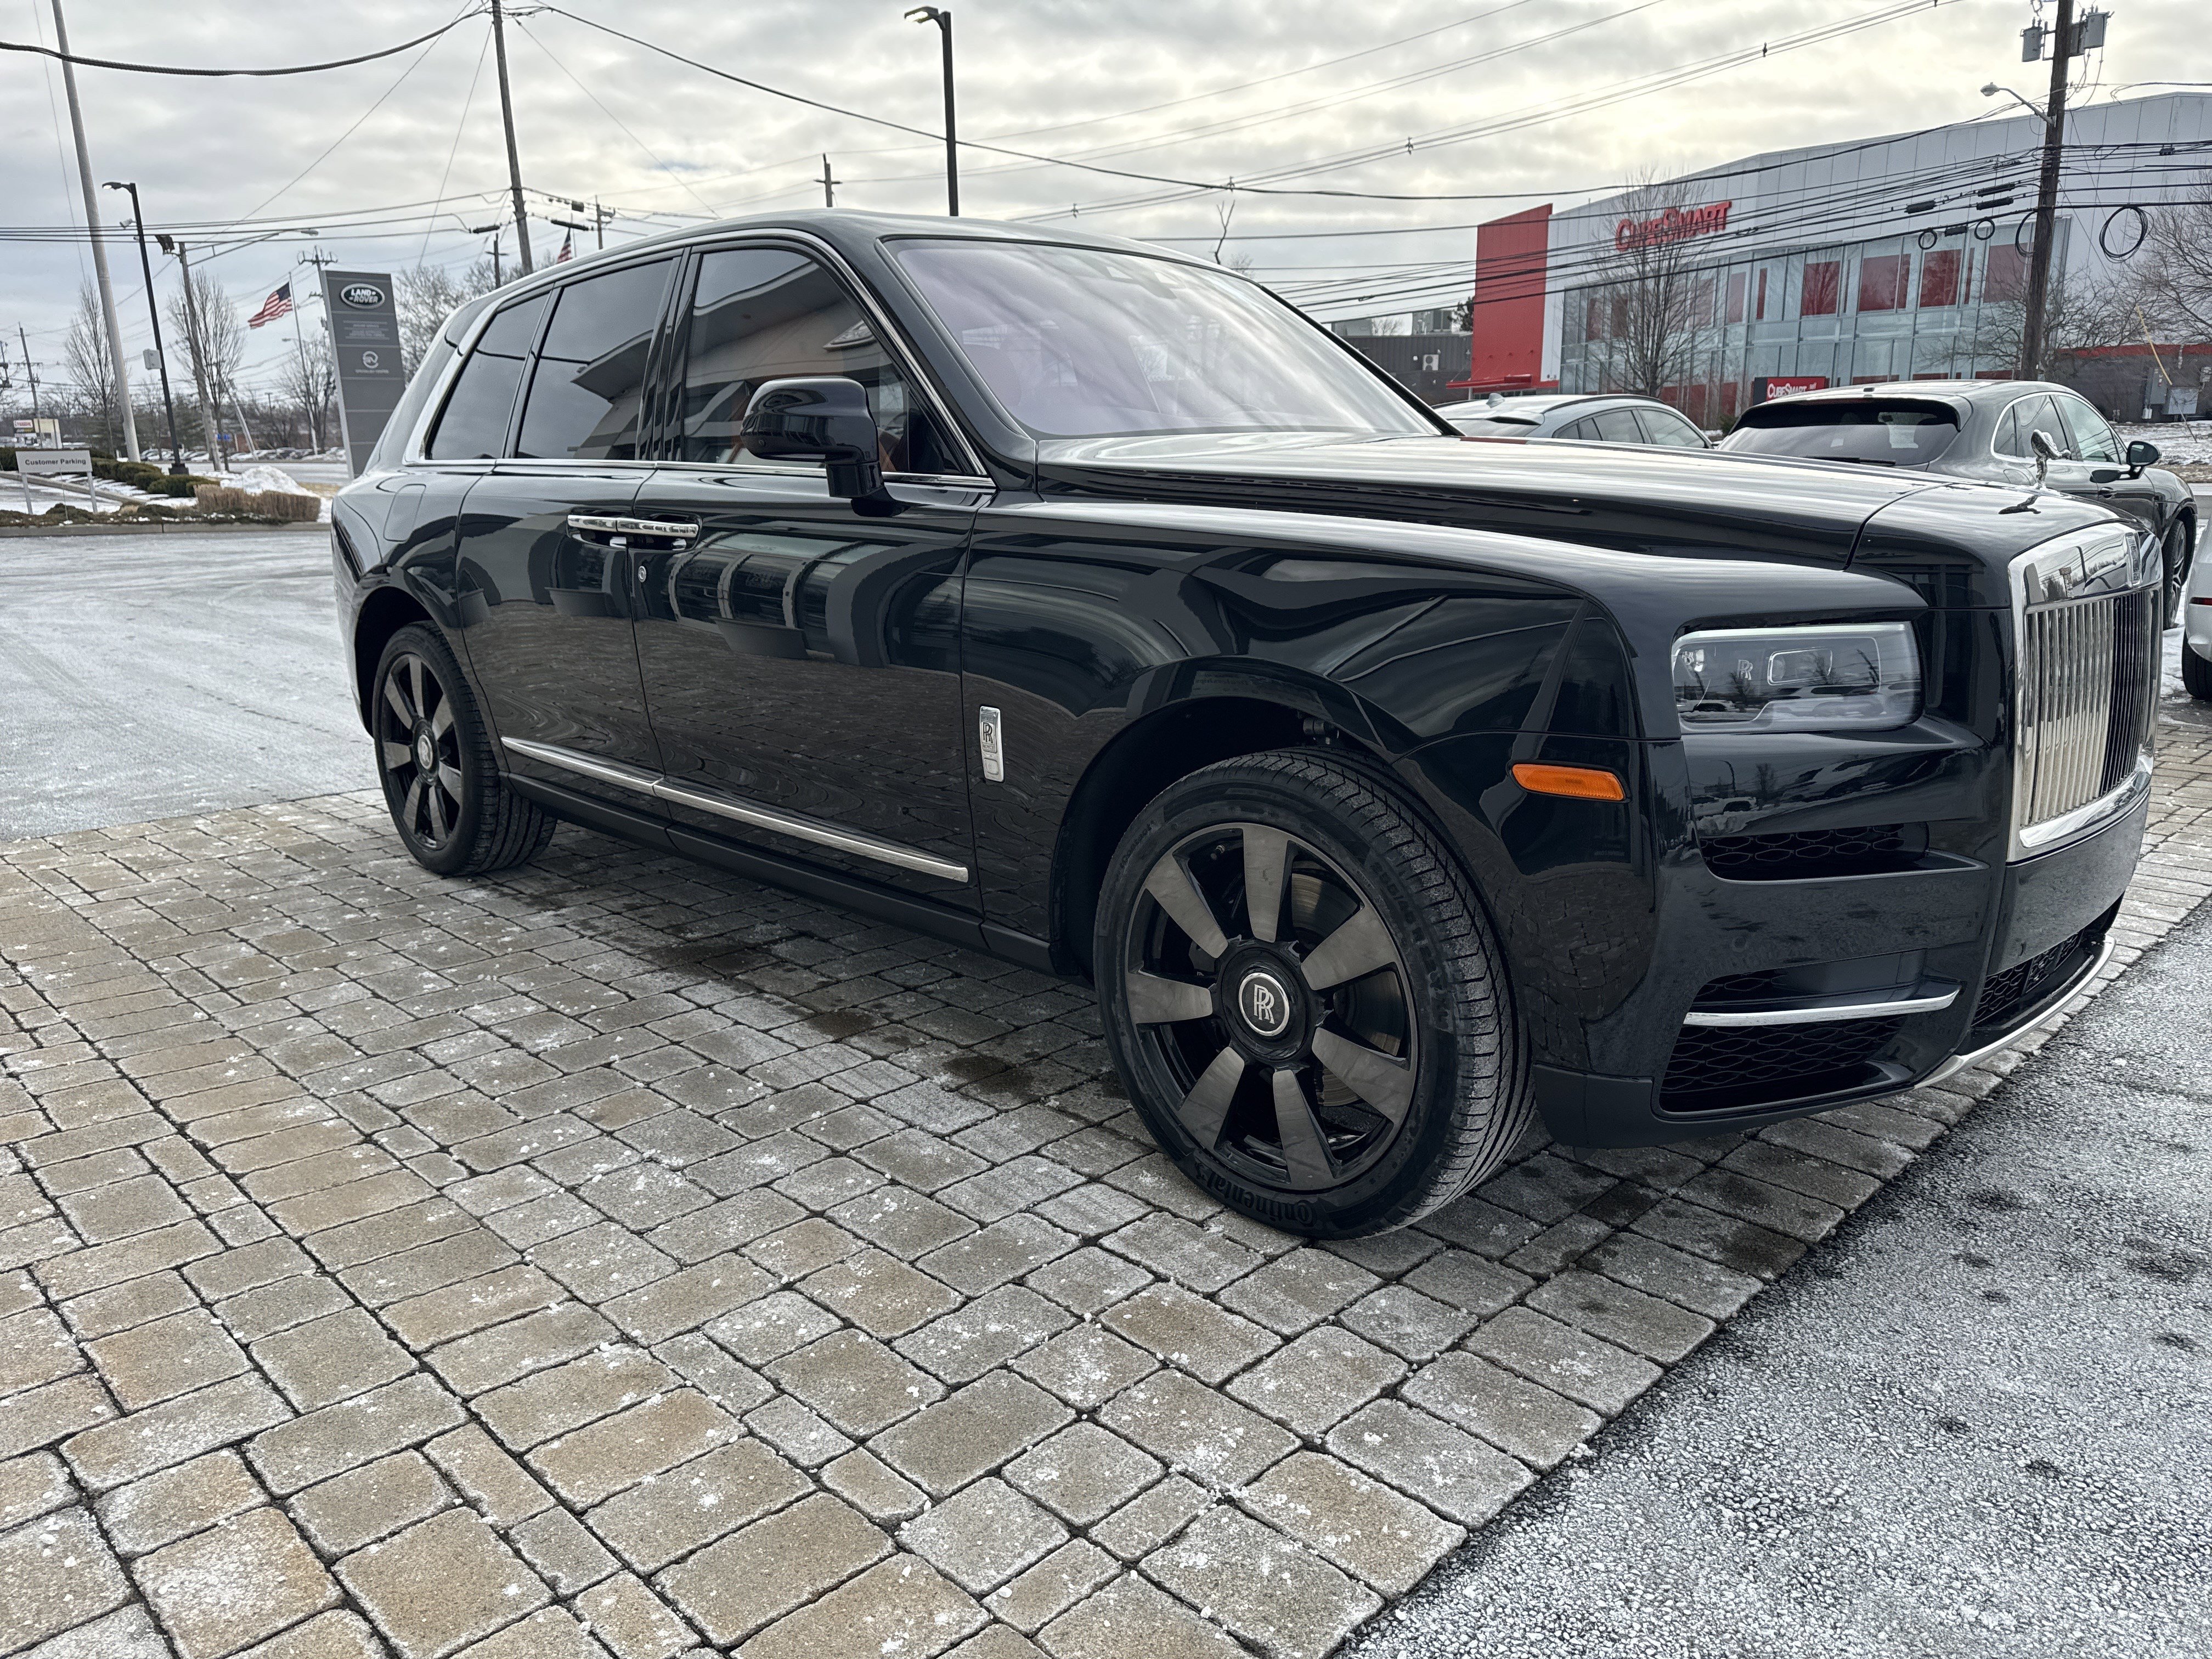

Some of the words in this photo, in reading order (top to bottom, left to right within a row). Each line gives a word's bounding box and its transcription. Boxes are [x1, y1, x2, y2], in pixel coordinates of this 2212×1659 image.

[351, 289, 372, 297] LAND
[353, 295, 379, 303] ROVER
[1254, 984, 1275, 1024] RR
[1207, 1170, 1316, 1227] Continental
